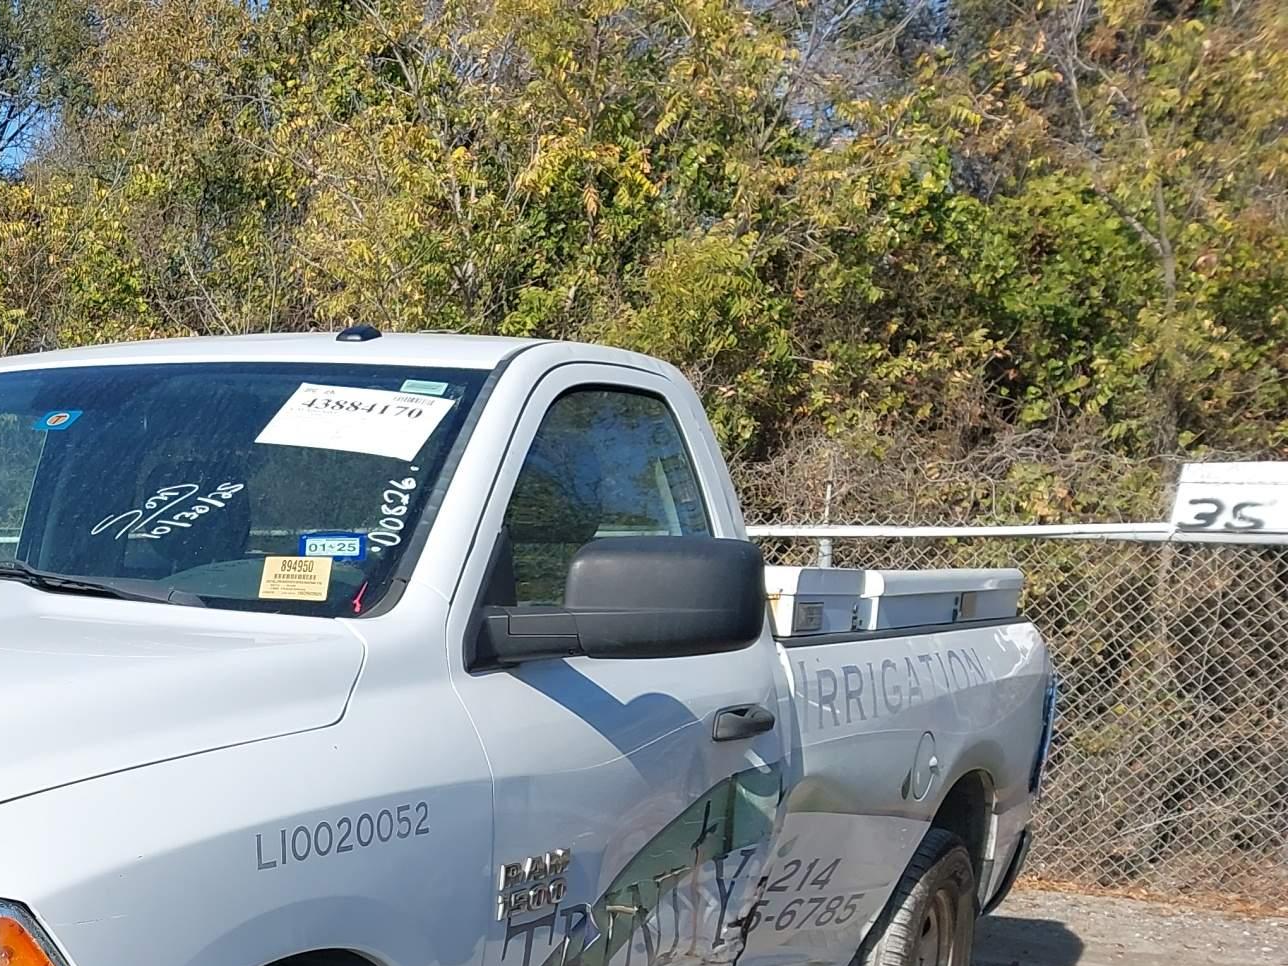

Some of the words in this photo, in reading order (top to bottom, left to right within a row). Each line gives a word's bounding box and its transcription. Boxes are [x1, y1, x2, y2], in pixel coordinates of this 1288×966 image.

[301, 397, 423, 419] 43884170
[280, 559, 314, 573] 894950
[798, 647, 988, 731] IRRIGATION
[496, 847, 570, 891] RAM
[495, 878, 568, 921] 1500
